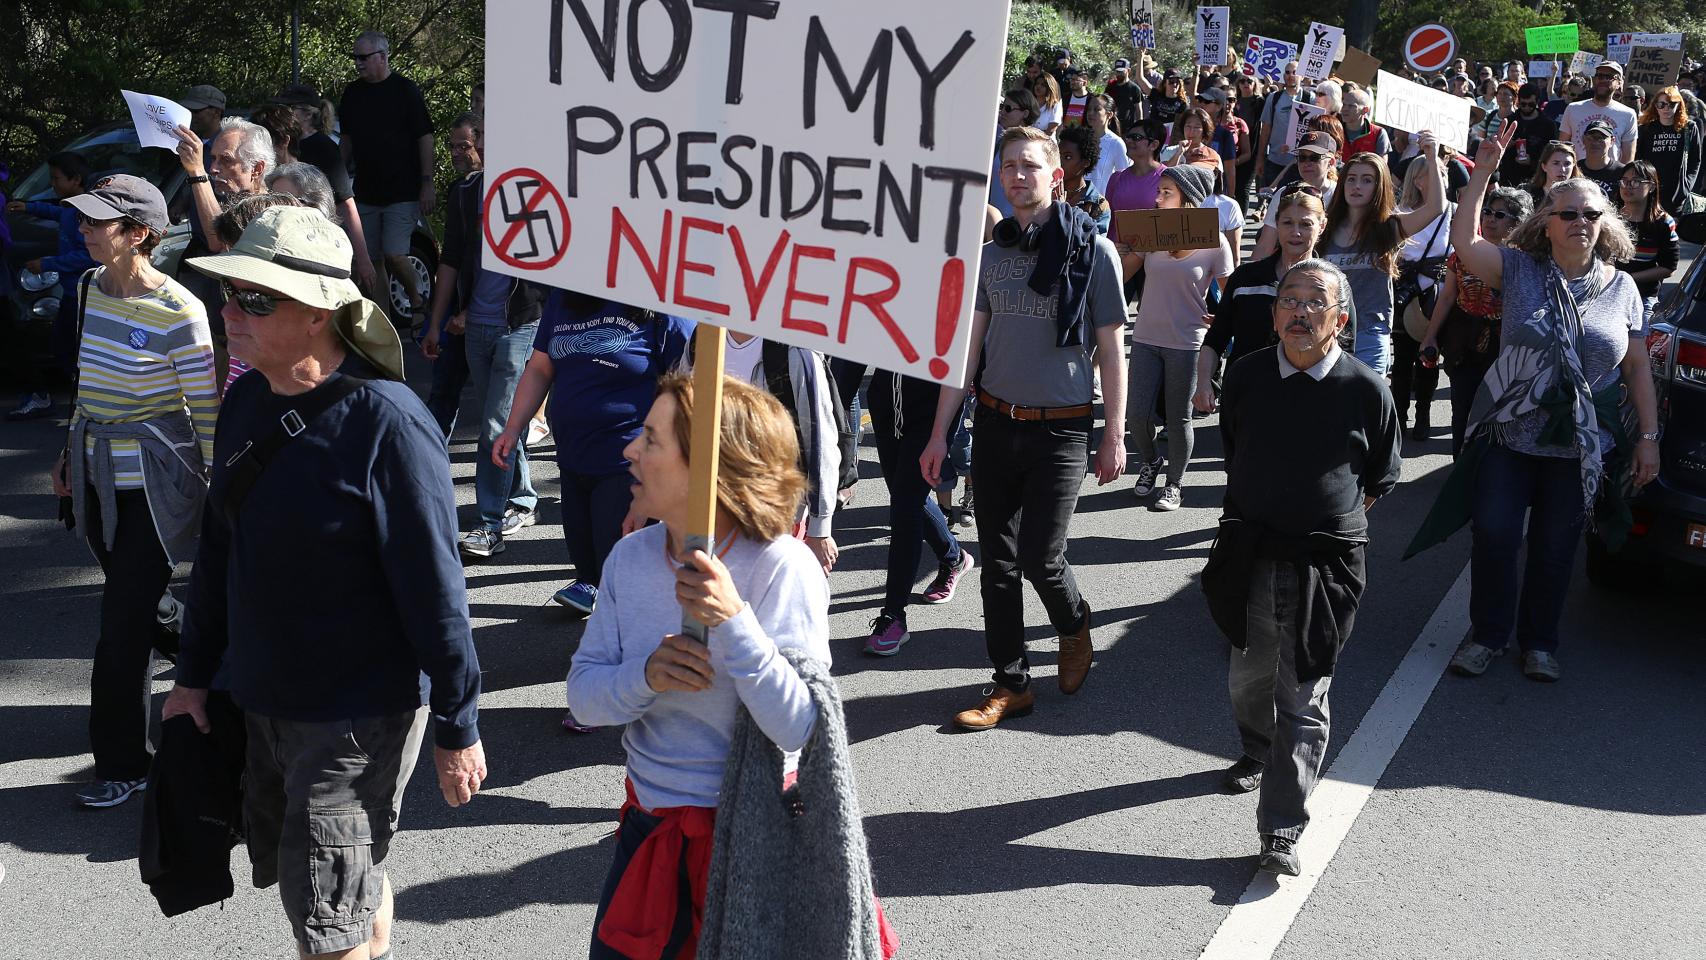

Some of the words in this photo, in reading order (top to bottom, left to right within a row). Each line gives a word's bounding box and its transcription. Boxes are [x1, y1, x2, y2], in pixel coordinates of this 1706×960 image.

[1200, 13, 1221, 29] YES
[1313, 28, 1332, 48] YES
[1609, 35, 1618, 46] I
[1243, 37, 1259, 75] USA
[1311, 48, 1328, 56] LOVE
[1632, 47, 1663, 60] LOVE
[1308, 59, 1323, 68] NO
[1632, 60, 1670, 72] TRUMPS
[549, 0, 780, 104] NOT
[804, 15, 975, 151] MY
[1628, 72, 1665, 84] HATE
[144, 103, 166, 115] LOVE
[1295, 108, 1310, 126] YE
[1385, 93, 1465, 148] KINDNESS
[566, 105, 988, 256] PRESIDENT
[607, 206, 966, 380] NEVER!
[553, 323, 572, 333] FOLLOW
[572, 321, 586, 332] YOUR
[602, 316, 615, 324] FIND
[615, 316, 630, 328] YOUR
[599, 359, 620, 369] BROOKS
